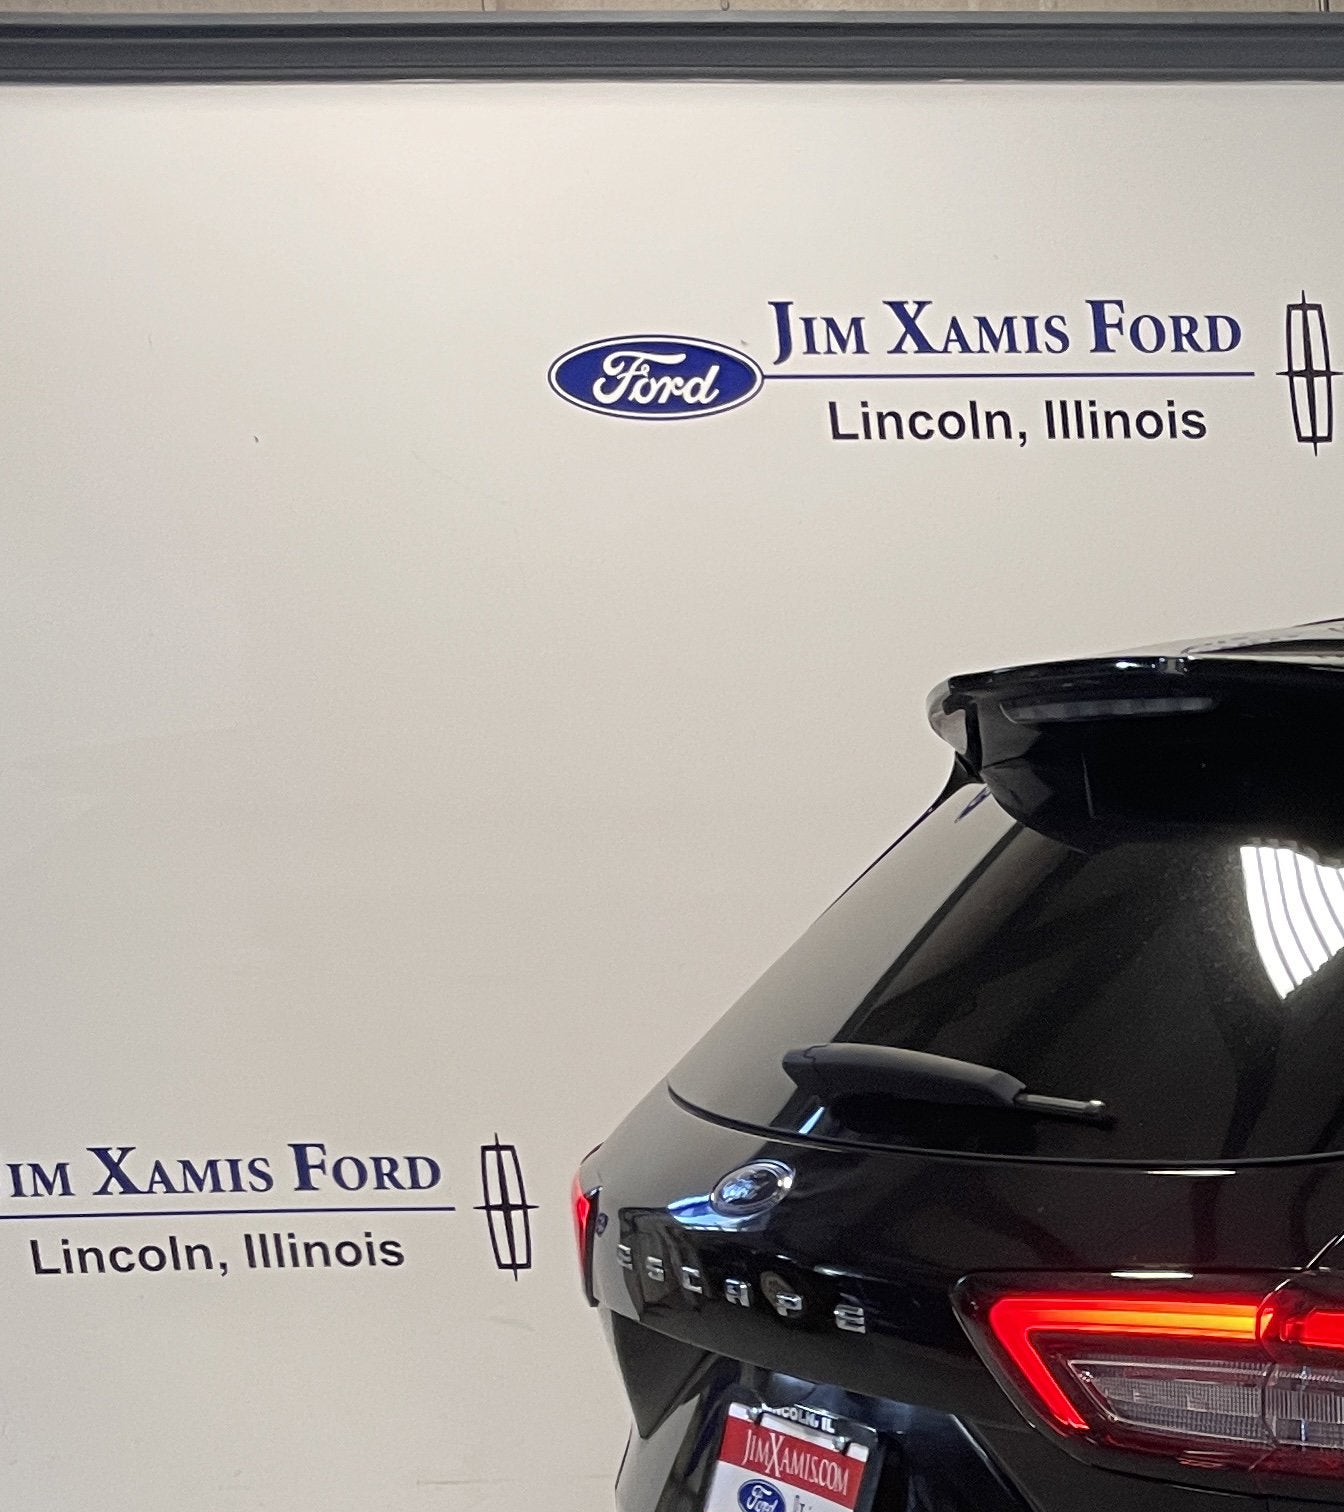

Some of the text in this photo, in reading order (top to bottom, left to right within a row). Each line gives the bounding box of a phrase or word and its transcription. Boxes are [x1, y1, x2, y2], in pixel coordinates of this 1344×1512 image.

[1085, 299, 1242, 354] FORD
[592, 349, 720, 408] Ford
[828, 399, 1207, 448] Lincoln, Illinois
[5, 1162, 76, 1198] IM
[287, 1143, 442, 1192] FORD
[29, 1231, 405, 1277] Lincoln, Illinois
[616, 1243, 867, 1335] ESCAPE
